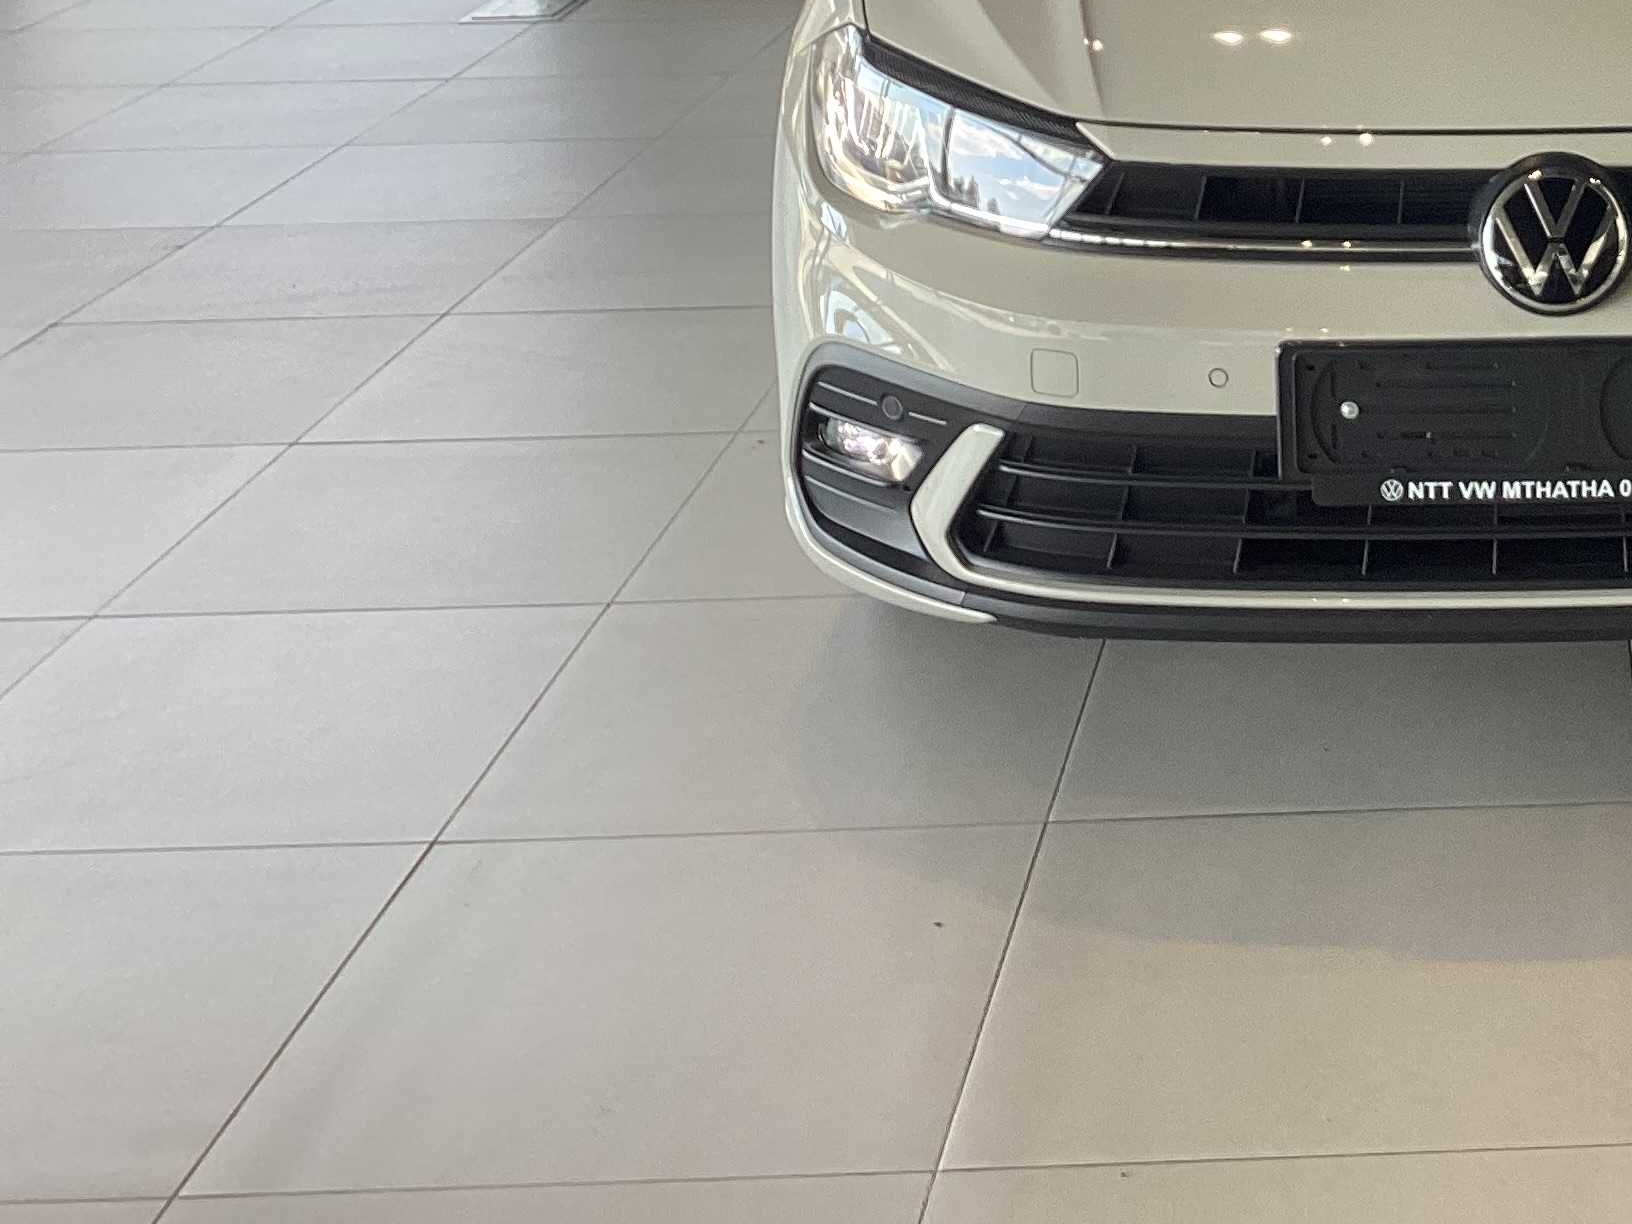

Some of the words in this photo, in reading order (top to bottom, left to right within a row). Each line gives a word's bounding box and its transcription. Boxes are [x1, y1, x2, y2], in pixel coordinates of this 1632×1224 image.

[1489, 171, 1621, 300] VW
[1407, 481, 1453, 500] NTT
[1458, 480, 1497, 500] VW
[1502, 479, 1615, 500] MTHATHA
